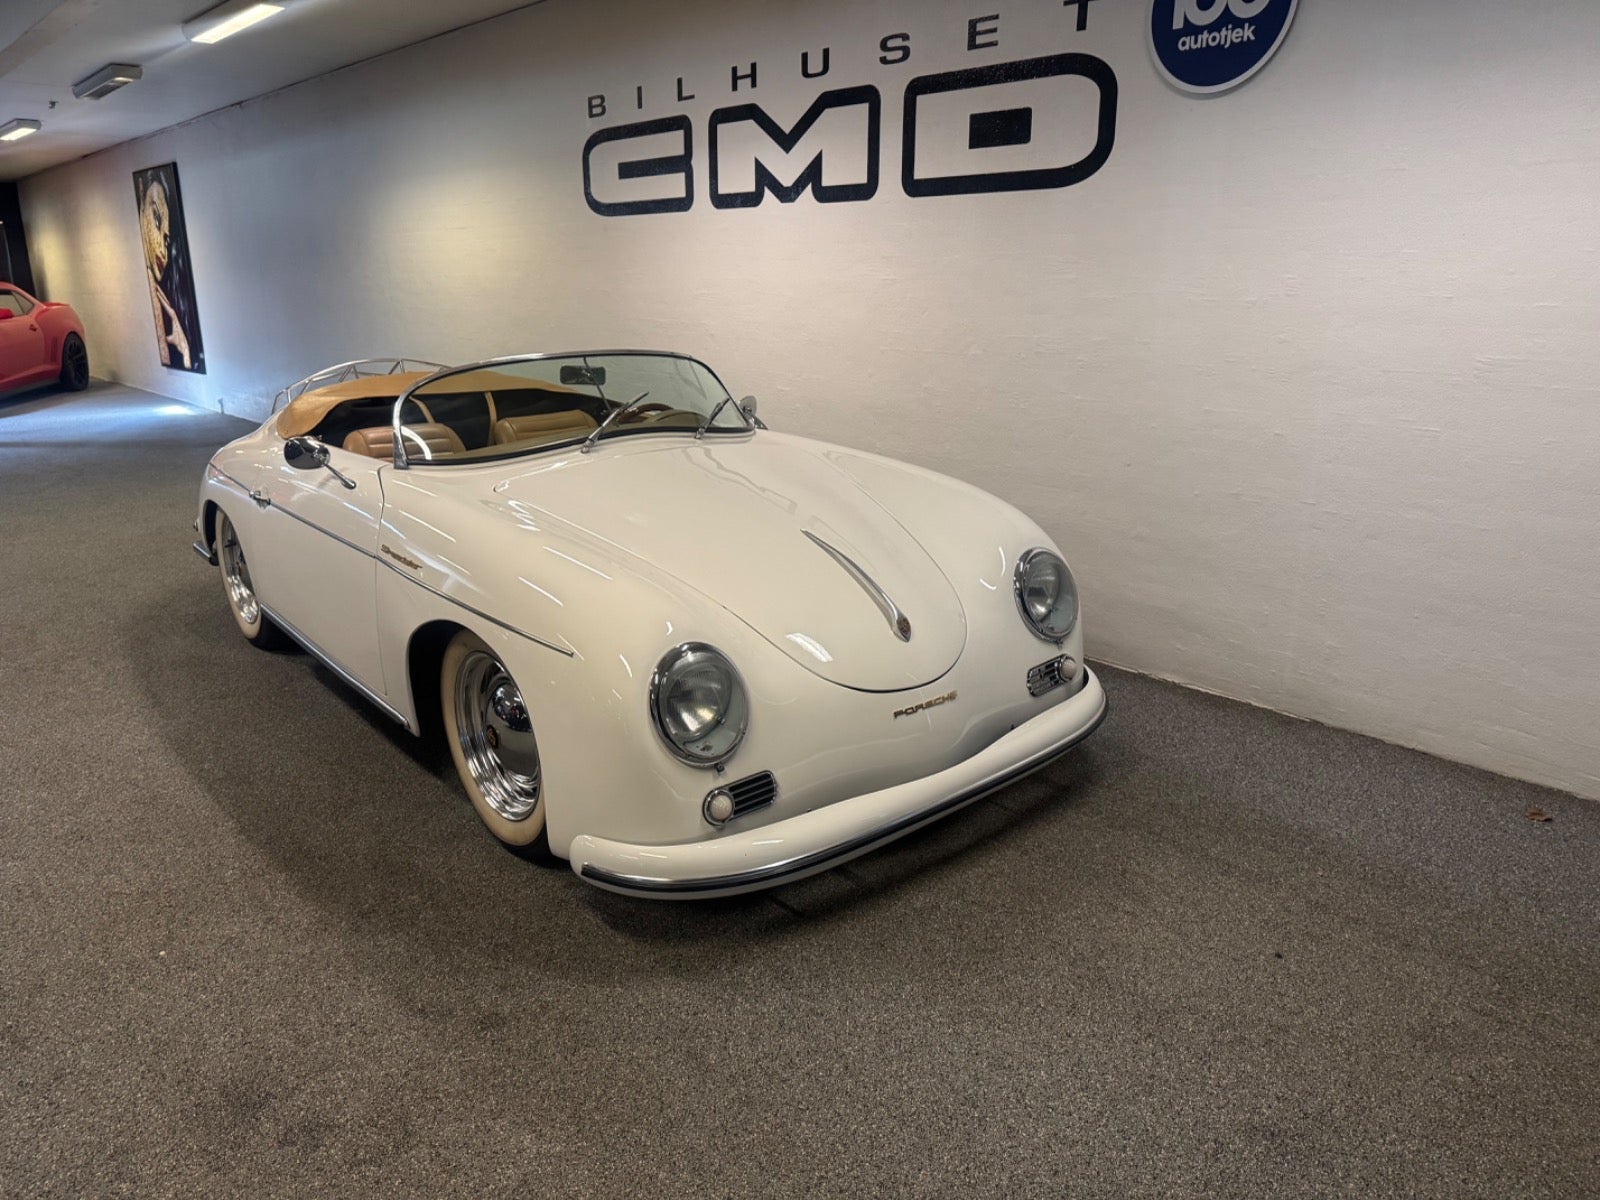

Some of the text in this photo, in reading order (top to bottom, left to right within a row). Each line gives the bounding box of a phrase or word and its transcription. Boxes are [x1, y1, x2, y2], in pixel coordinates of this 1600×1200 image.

[587, 0, 1101, 119] BILHUSET
[1177, 22, 1256, 52] autotjek
[582, 52, 1119, 217] CMD
